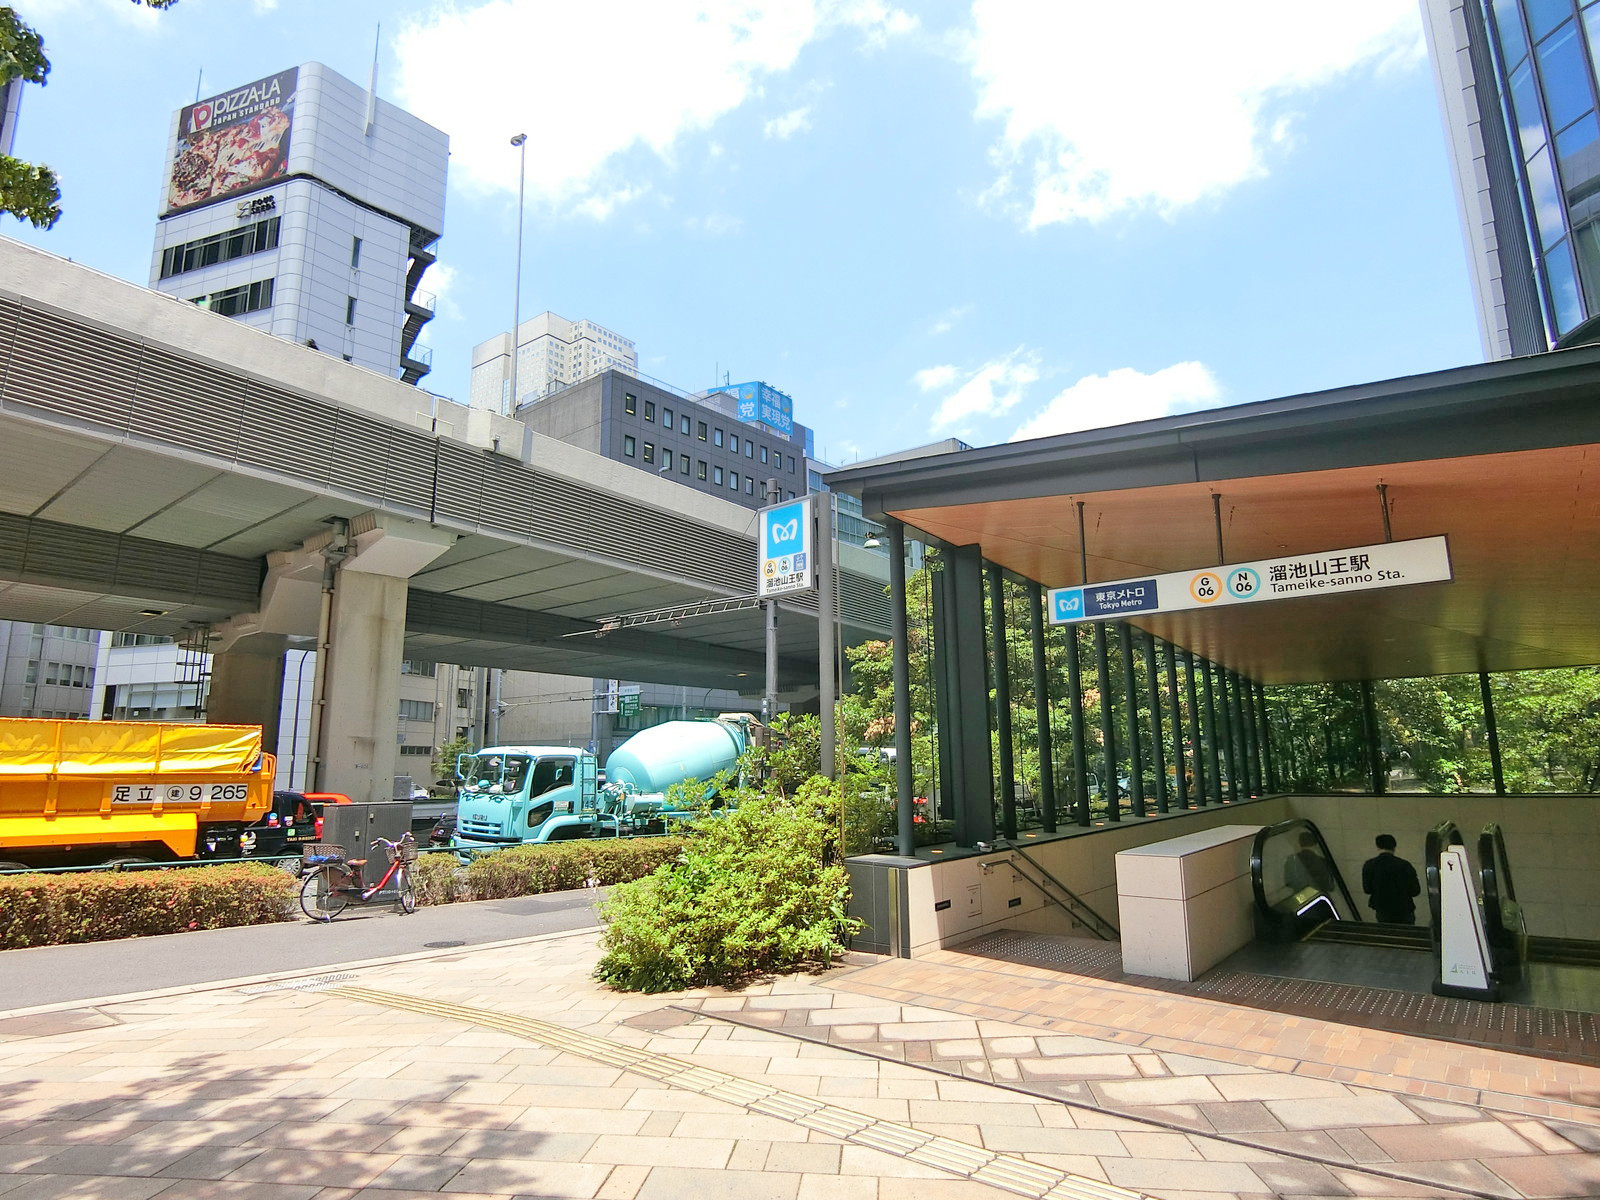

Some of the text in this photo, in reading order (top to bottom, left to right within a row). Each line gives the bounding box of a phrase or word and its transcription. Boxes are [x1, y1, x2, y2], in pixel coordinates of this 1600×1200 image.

[213, 78, 281, 117] PIZZA-LA
[213, 96, 281, 126] JAPAN STANDARD
[761, 387, 781, 410] 幸福
[761, 403, 790, 430] 実現党
[1269, 553, 1371, 582] 溜池山王駅
[766, 572, 804, 588] 溜池山王駅
[1200, 577, 1210, 586] G
[1238, 573, 1248, 582] N
[1270, 569, 1405, 593] Tameike-sanno Sta.
[1095, 586, 1145, 602] 東京メトロ
[1198, 587, 1215, 597] 06
[1235, 582, 1252, 593] 06
[1098, 598, 1143, 610] Tokyo Metro
[113, 785, 154, 802] 足立
[189, 785, 202, 801] 9
[211, 785, 247, 800] 265
